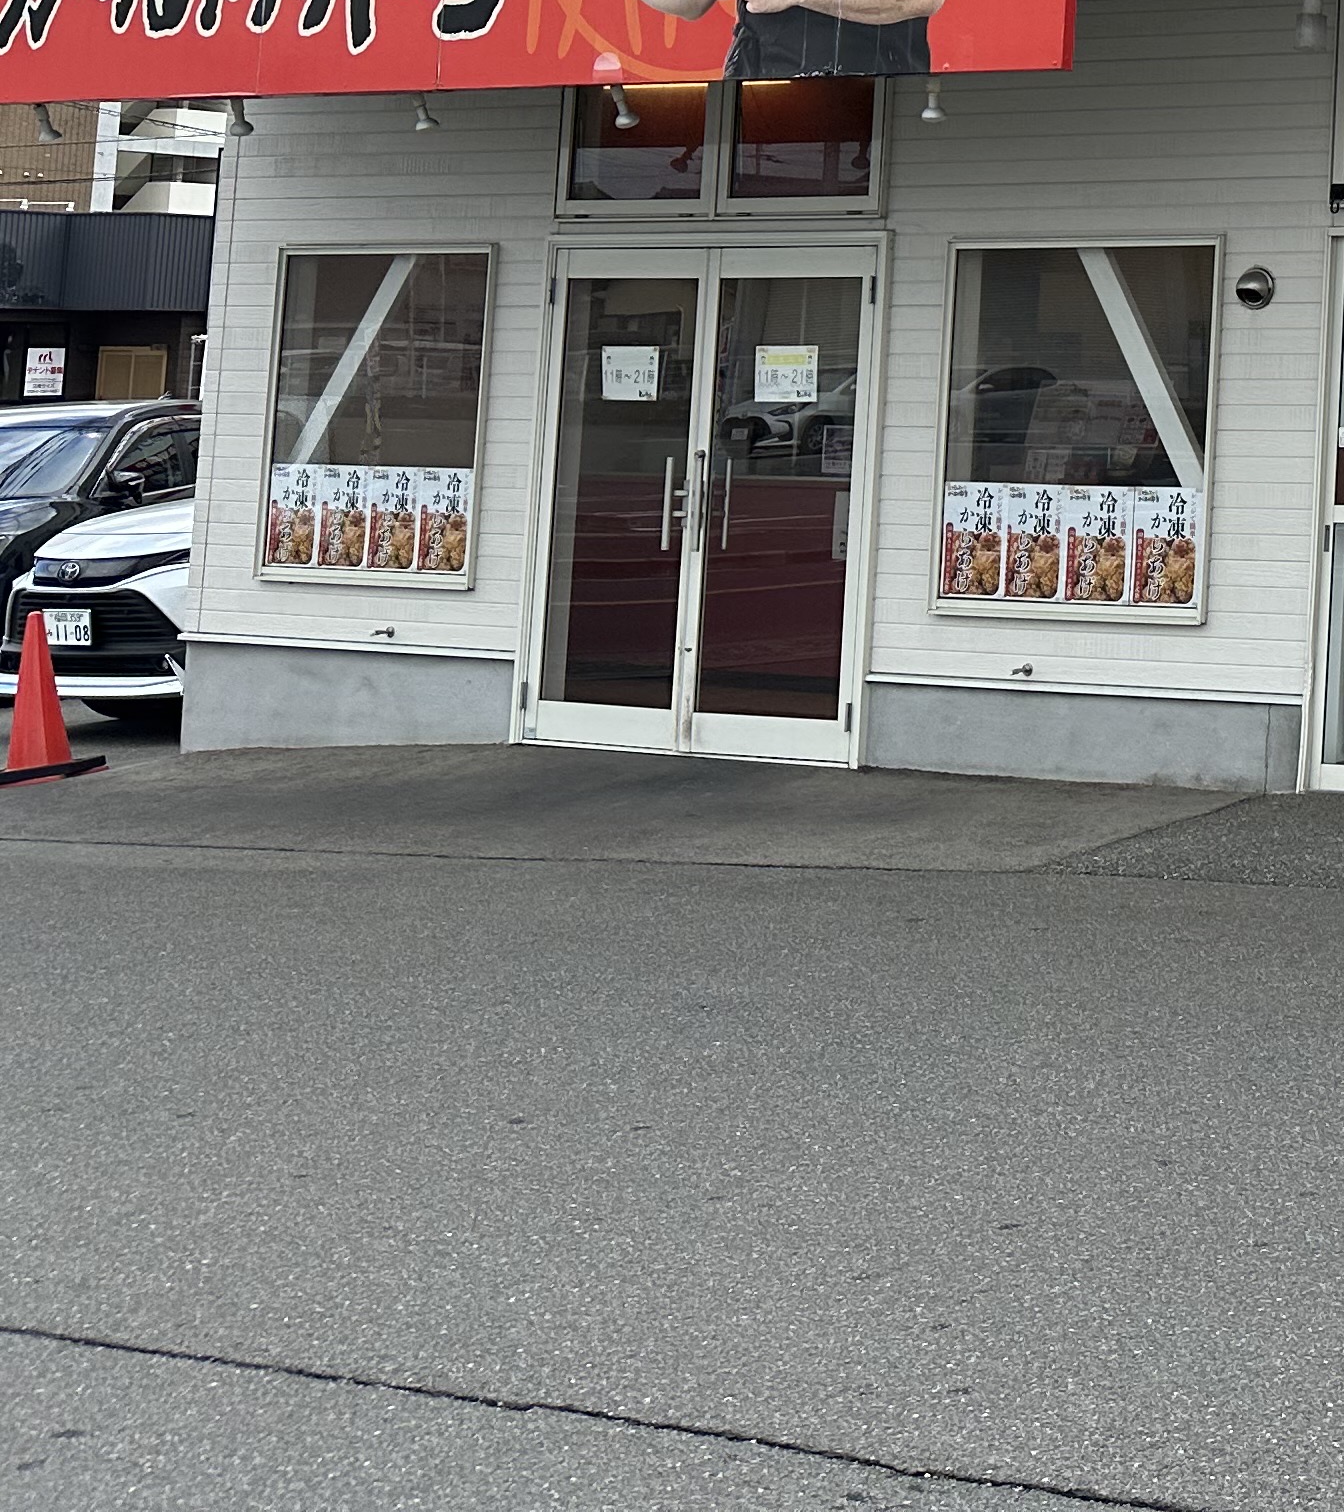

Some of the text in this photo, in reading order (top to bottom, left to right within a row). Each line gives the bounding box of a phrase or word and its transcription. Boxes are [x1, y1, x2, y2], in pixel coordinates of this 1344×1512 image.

[975, 487, 994, 532] 冷凍
[1034, 489, 1053, 535] 冷凍
[1099, 491, 1118, 538] 冷凍
[1167, 492, 1187, 539] 冷凍
[956, 507, 975, 592] からあげ
[1014, 509, 1033, 595] からあげ
[1080, 512, 1098, 598] からあげ
[1148, 513, 1166, 600] からあげ
